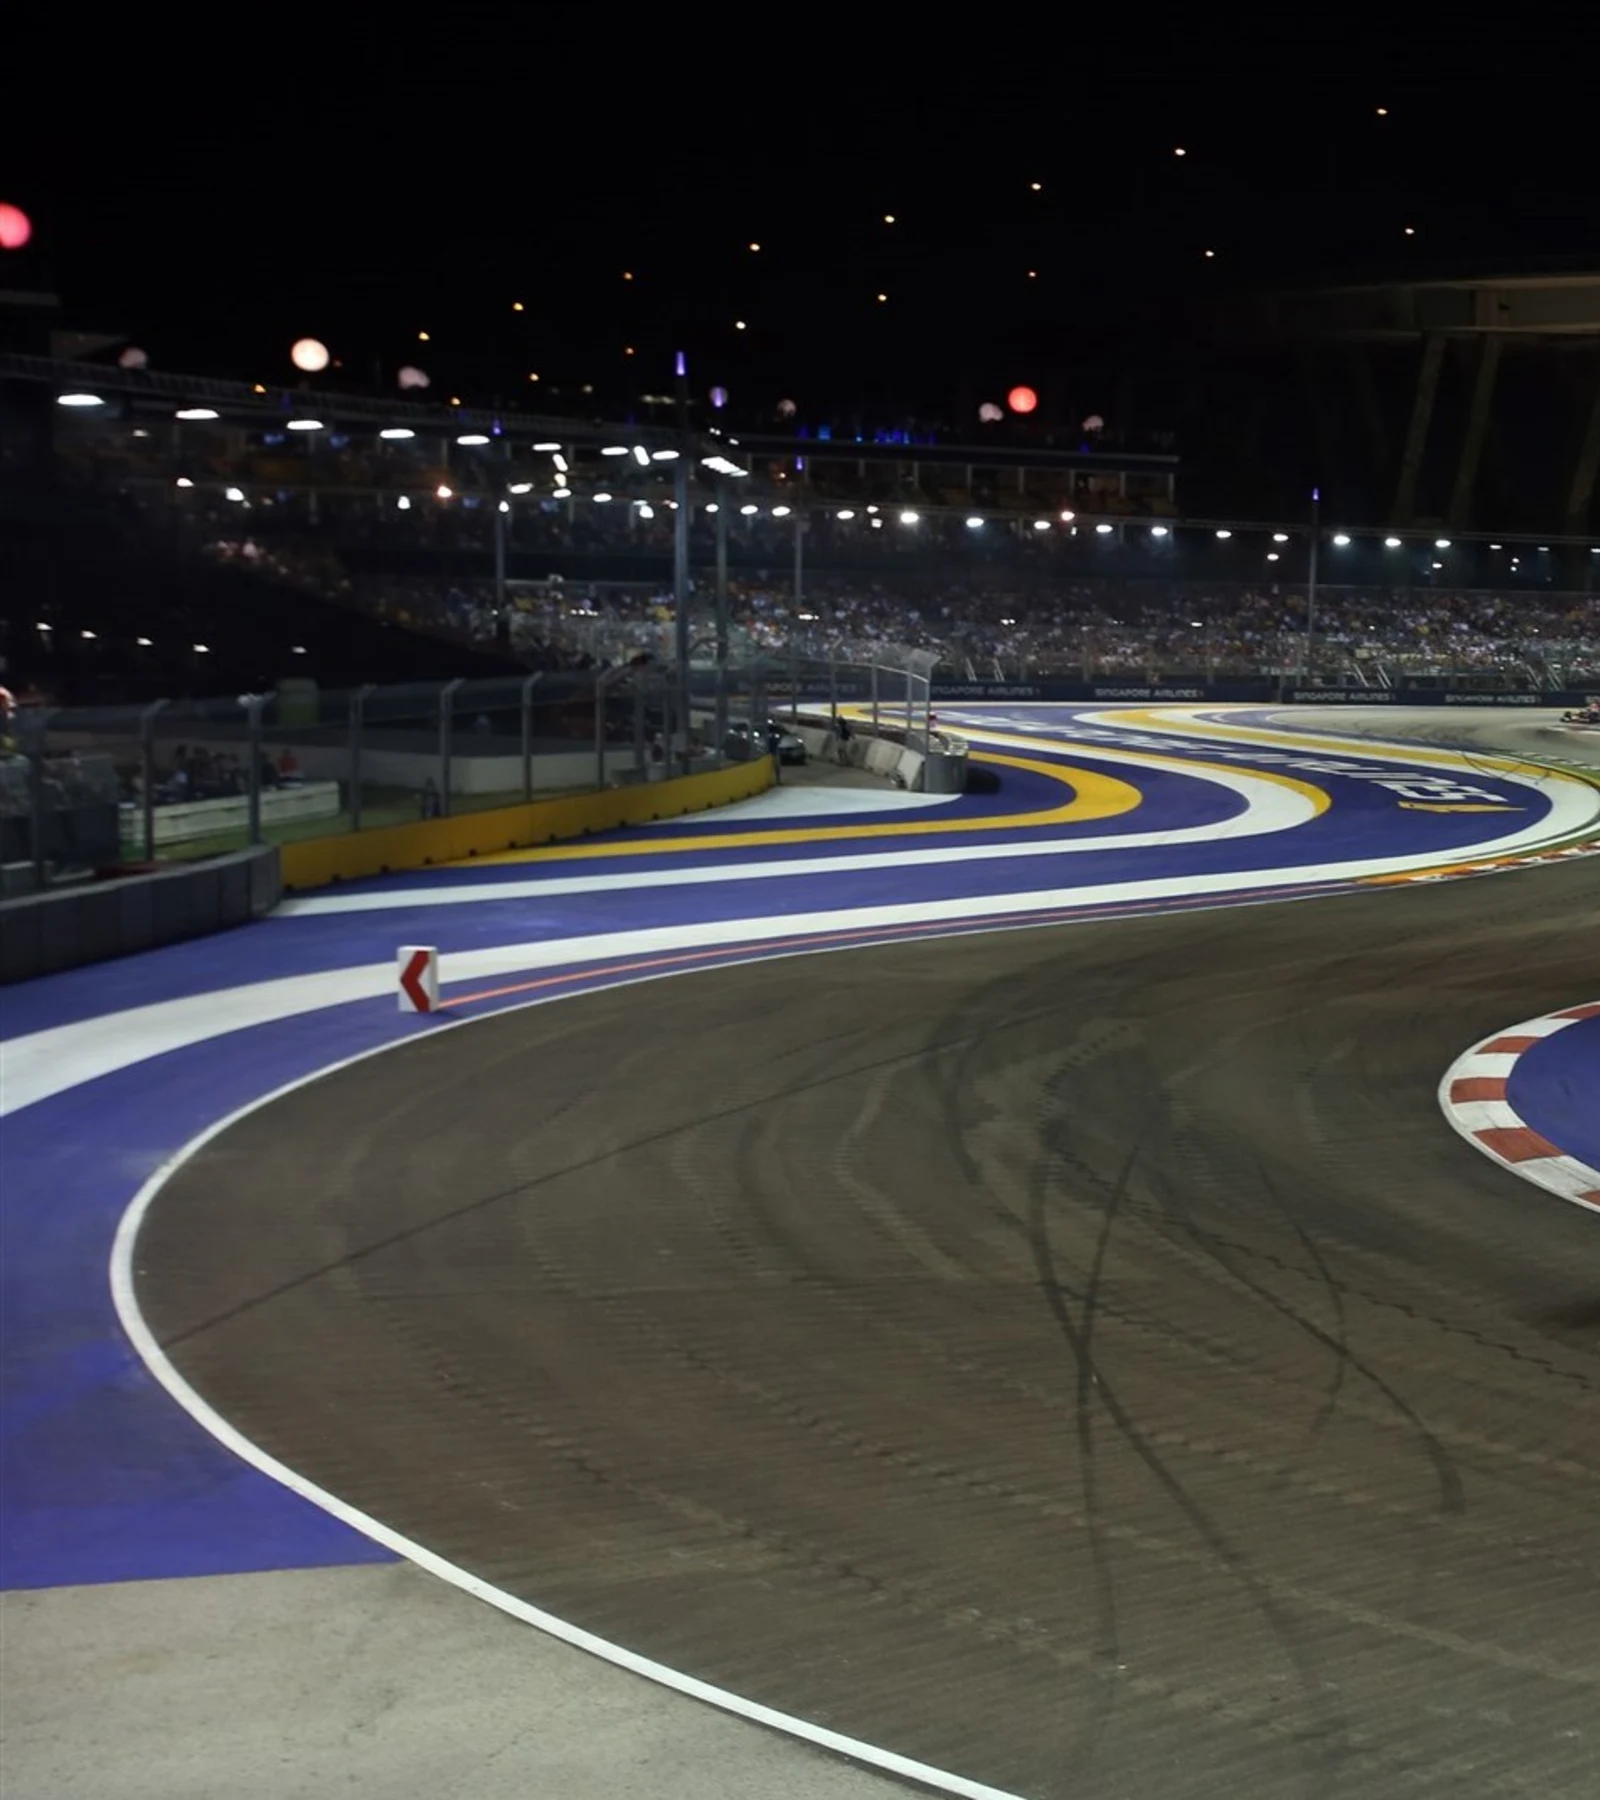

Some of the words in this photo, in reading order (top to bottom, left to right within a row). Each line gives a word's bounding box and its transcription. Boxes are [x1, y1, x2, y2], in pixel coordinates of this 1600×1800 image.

[987, 685, 1034, 696] AIRLINES
[1094, 688, 1151, 698] SINGAPORE
[1154, 688, 1197, 698] AIRLINES
[1293, 691, 1346, 701] SINGAPORE
[1348, 691, 1390, 701] AIRLINES
[1445, 693, 1494, 703] SINGAPORE
[1496, 693, 1536, 703] AIRLINES
